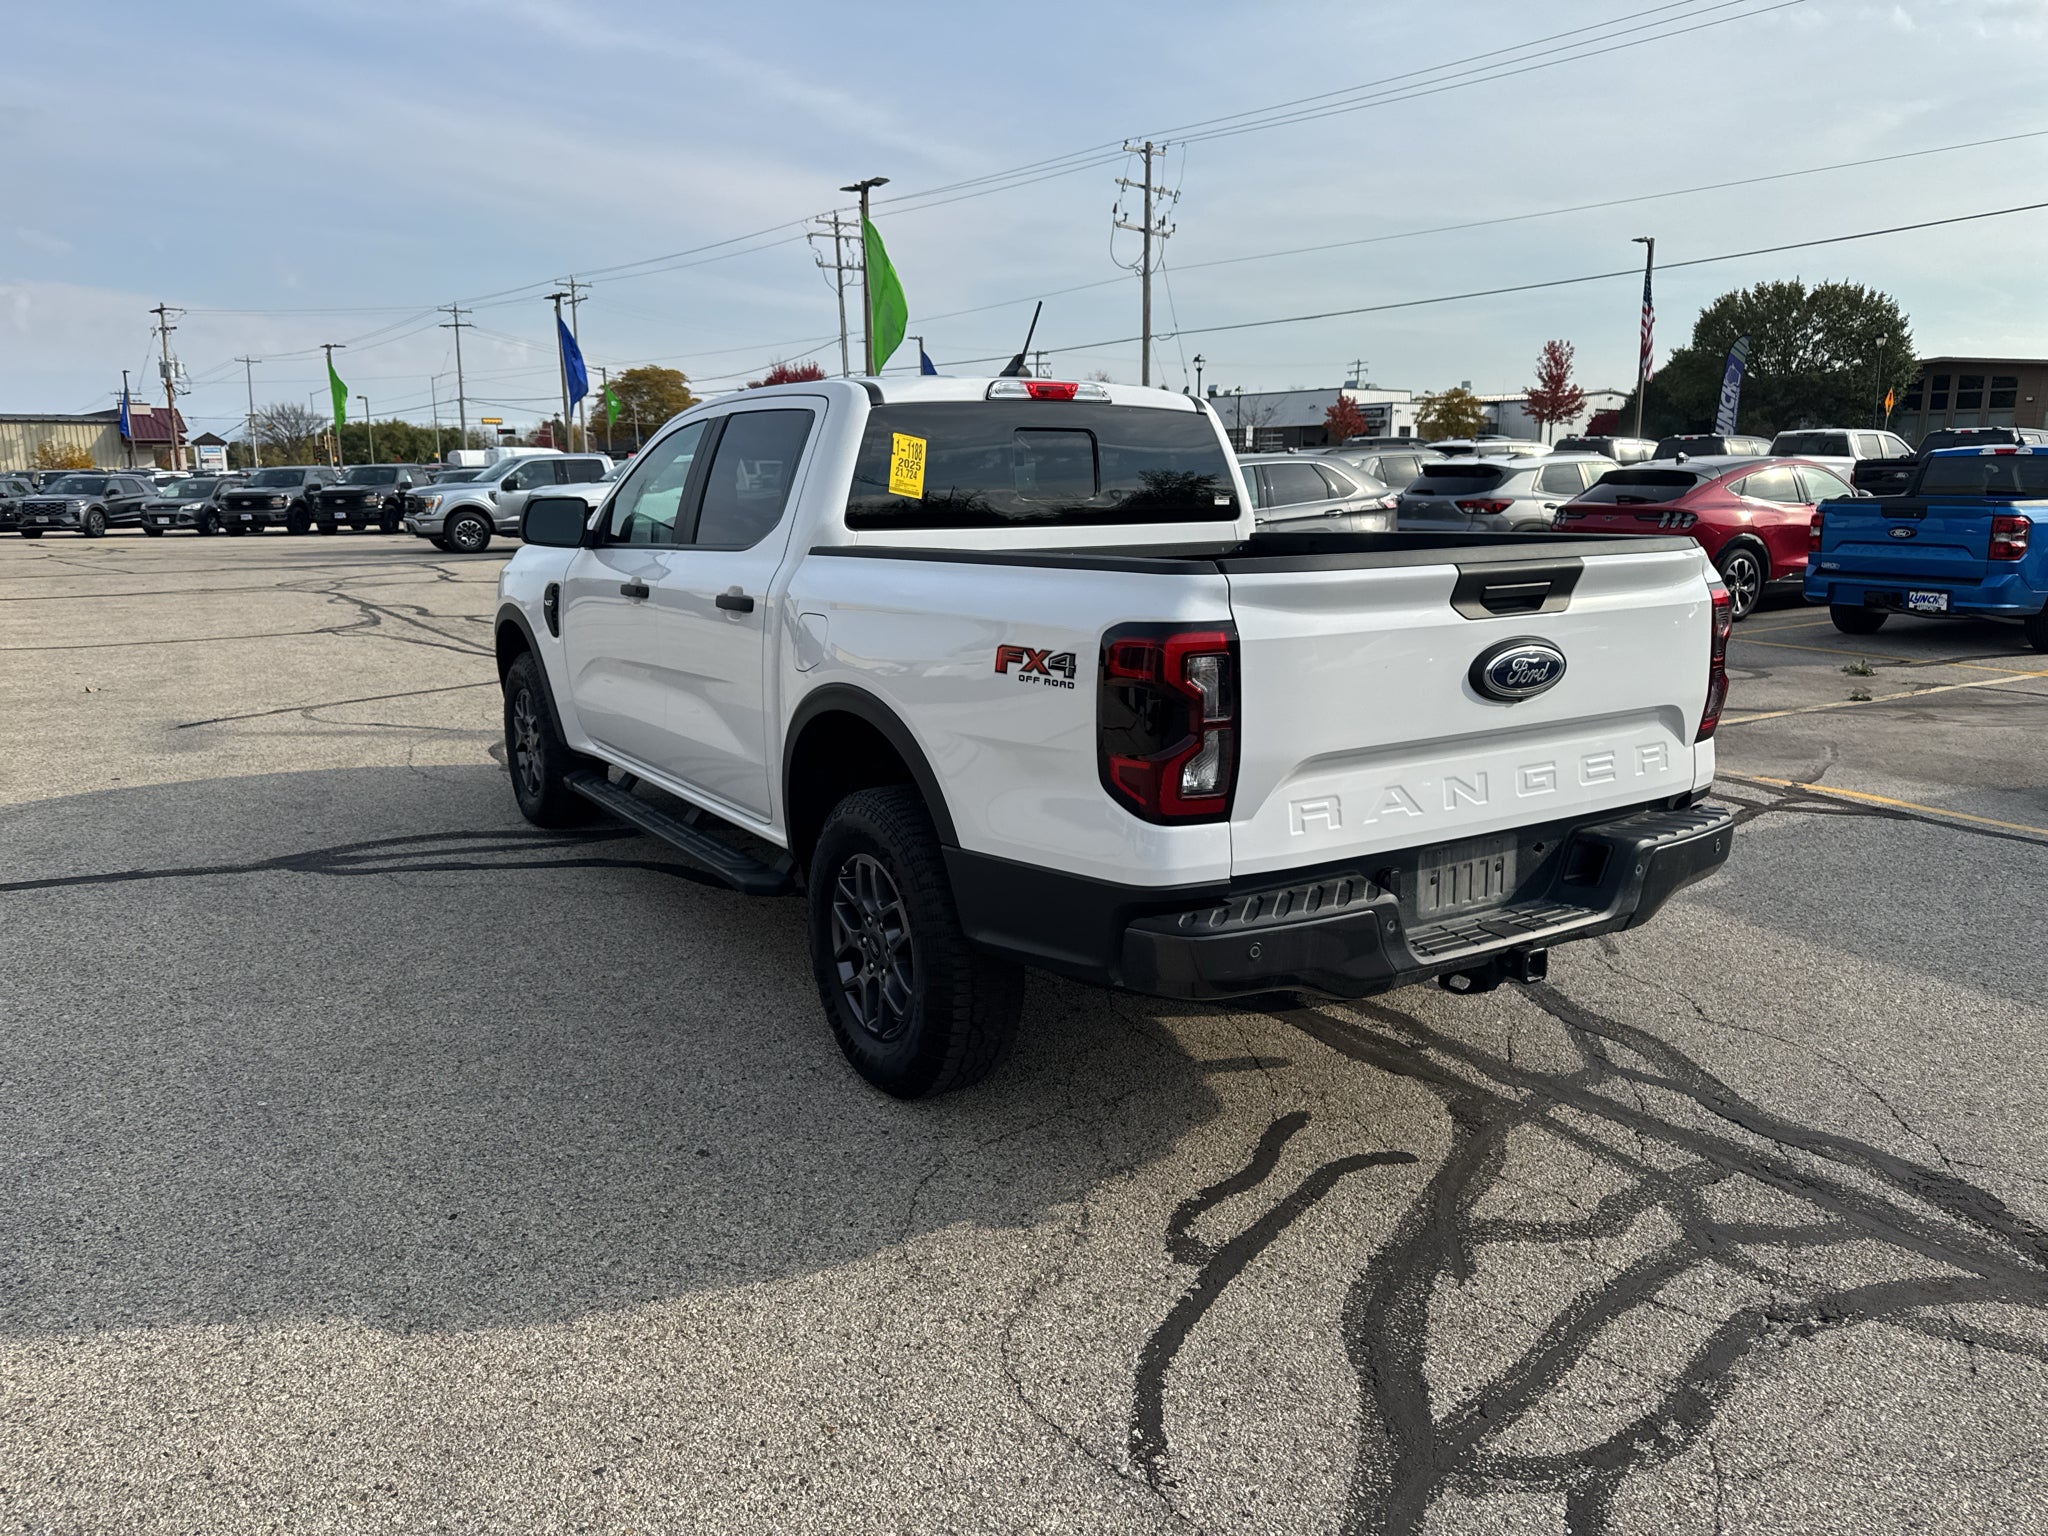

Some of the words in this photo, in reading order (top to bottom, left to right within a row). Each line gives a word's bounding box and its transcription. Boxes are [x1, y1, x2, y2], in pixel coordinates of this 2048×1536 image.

[1714, 380, 1739, 436] YNCH
[895, 467, 917, 480] 21,724
[898, 458, 921, 471] 2025
[995, 644, 1076, 679] FX4
[1506, 656, 1551, 686] Ford
[1018, 674, 1040, 684] OFF
[1043, 678, 1075, 690] ROAD
[1288, 741, 1670, 836] RANGER
